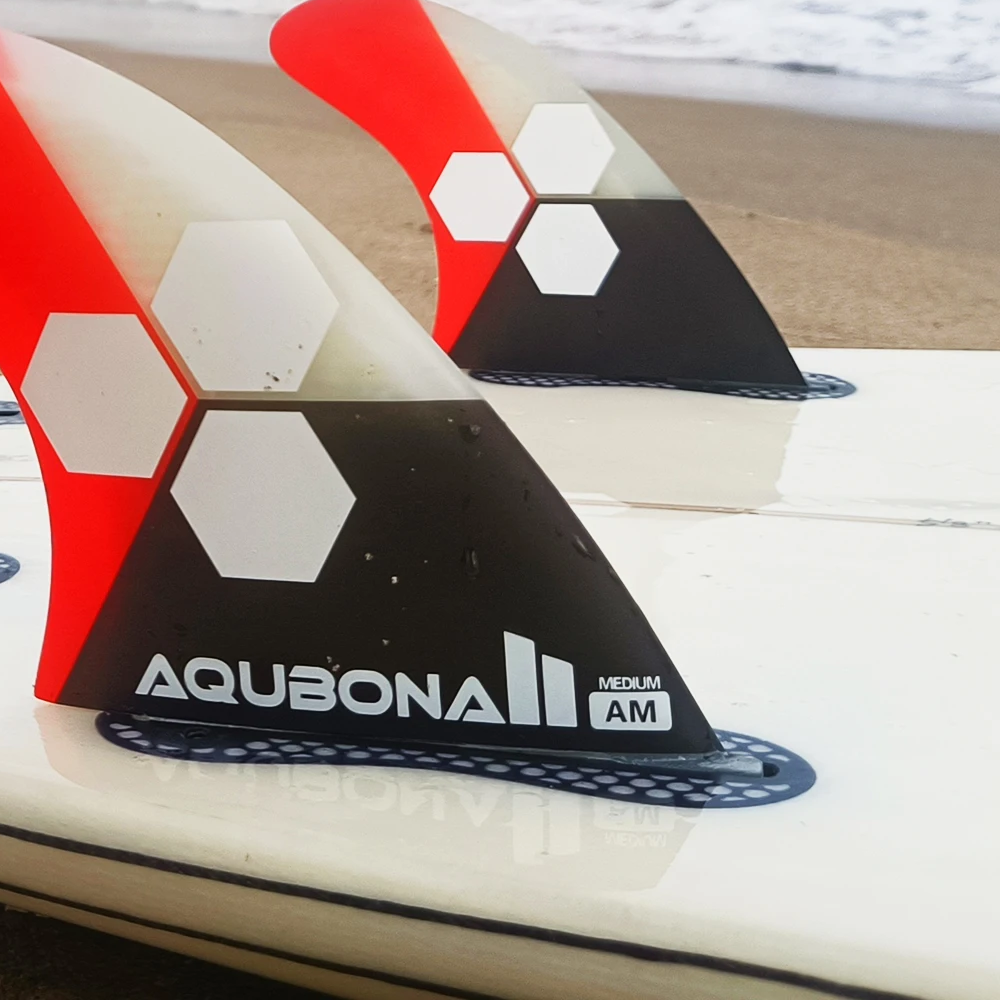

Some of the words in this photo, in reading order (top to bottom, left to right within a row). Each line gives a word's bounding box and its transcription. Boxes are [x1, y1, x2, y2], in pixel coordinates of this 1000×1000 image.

[134, 653, 507, 725] AQUBONA
[598, 675, 662, 691] MEDIUM
[605, 699, 657, 723] AM
